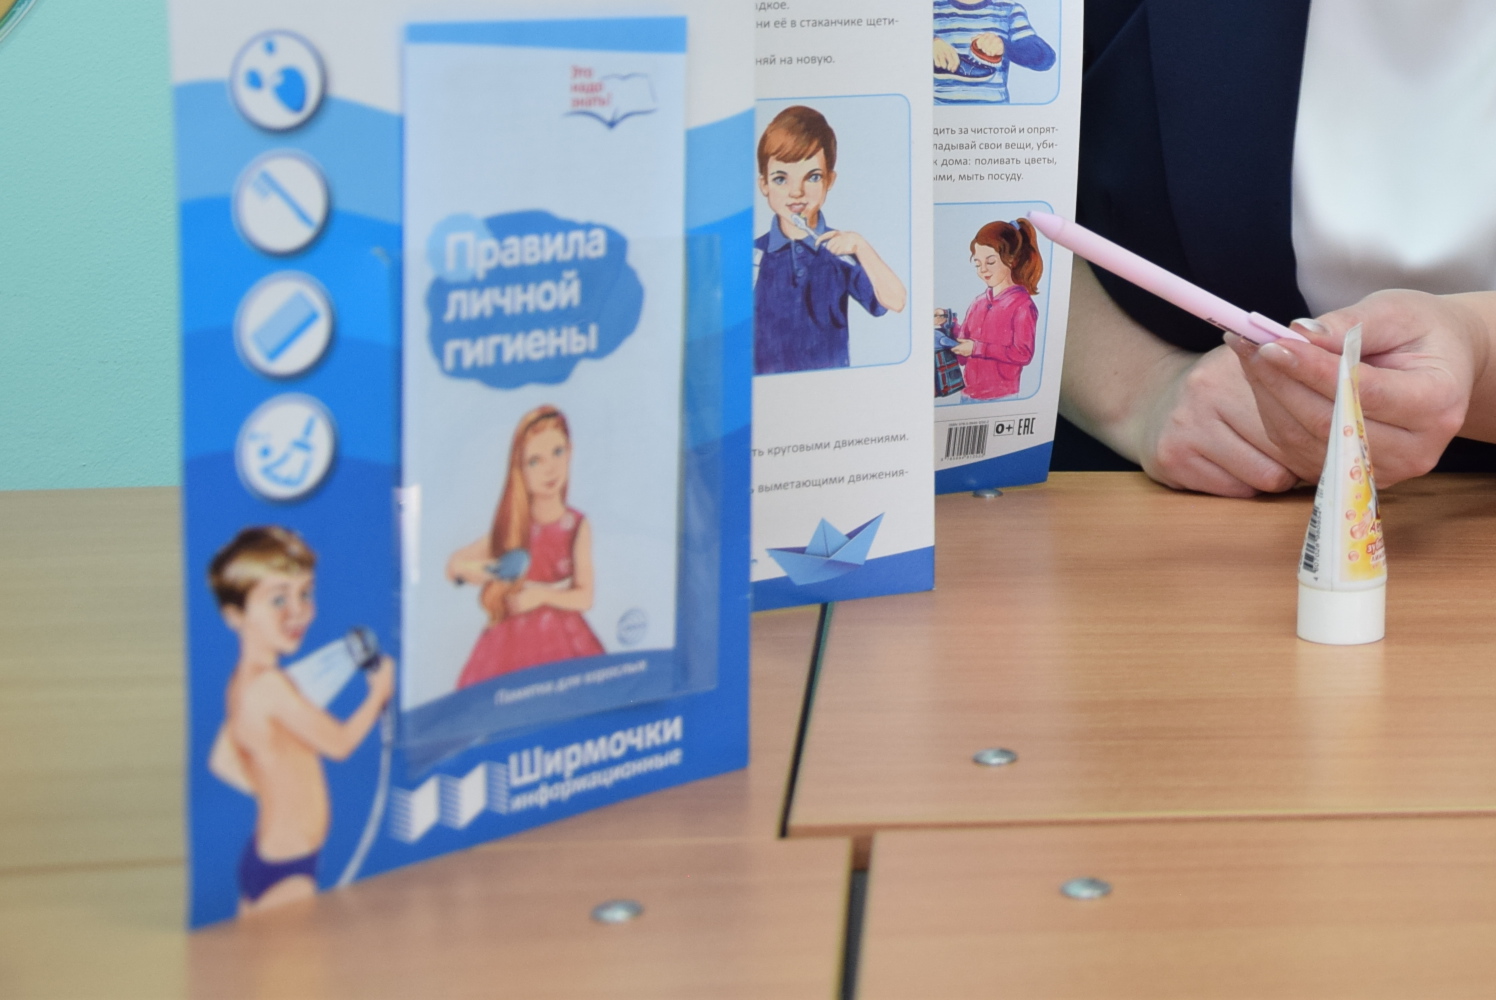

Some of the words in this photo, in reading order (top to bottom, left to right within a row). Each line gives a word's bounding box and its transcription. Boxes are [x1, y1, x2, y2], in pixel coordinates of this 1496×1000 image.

[756, 20, 771, 29] ни
[773, 18, 788, 29] её
[790, 19, 798, 29] в
[799, 17, 864, 29] стаканчике
[866, 16, 900, 28] щети-
[755, 54, 776, 66] няй
[779, 56, 793, 66] на
[796, 54, 836, 66] новую.
[958, 127, 969, 135] за
[971, 125, 1017, 135] чистотой
[1018, 126, 1025, 134] и
[1026, 125, 1059, 136] опрят-
[978, 141, 1003, 150] свои
[1004, 141, 1034, 151] вещи,
[1036, 140, 1058, 151] уби-
[940, 158, 971, 168] дома:
[974, 157, 1021, 166] поливать
[1024, 156, 1057, 167] цветы,
[958, 173, 985, 181] мыть
[987, 172, 1024, 182] посуду.
[443, 226, 608, 281] Правила
[442, 268, 582, 323] личной
[442, 323, 598, 373] гигиены
[995, 423, 1013, 435] 0+
[767, 441, 831, 457] круговыми
[833, 433, 909, 450] движениями.
[757, 476, 845, 494] выметающими
[847, 469, 909, 484] движения-
[507, 714, 683, 787] Ширмочки
[509, 747, 684, 811] информационные
